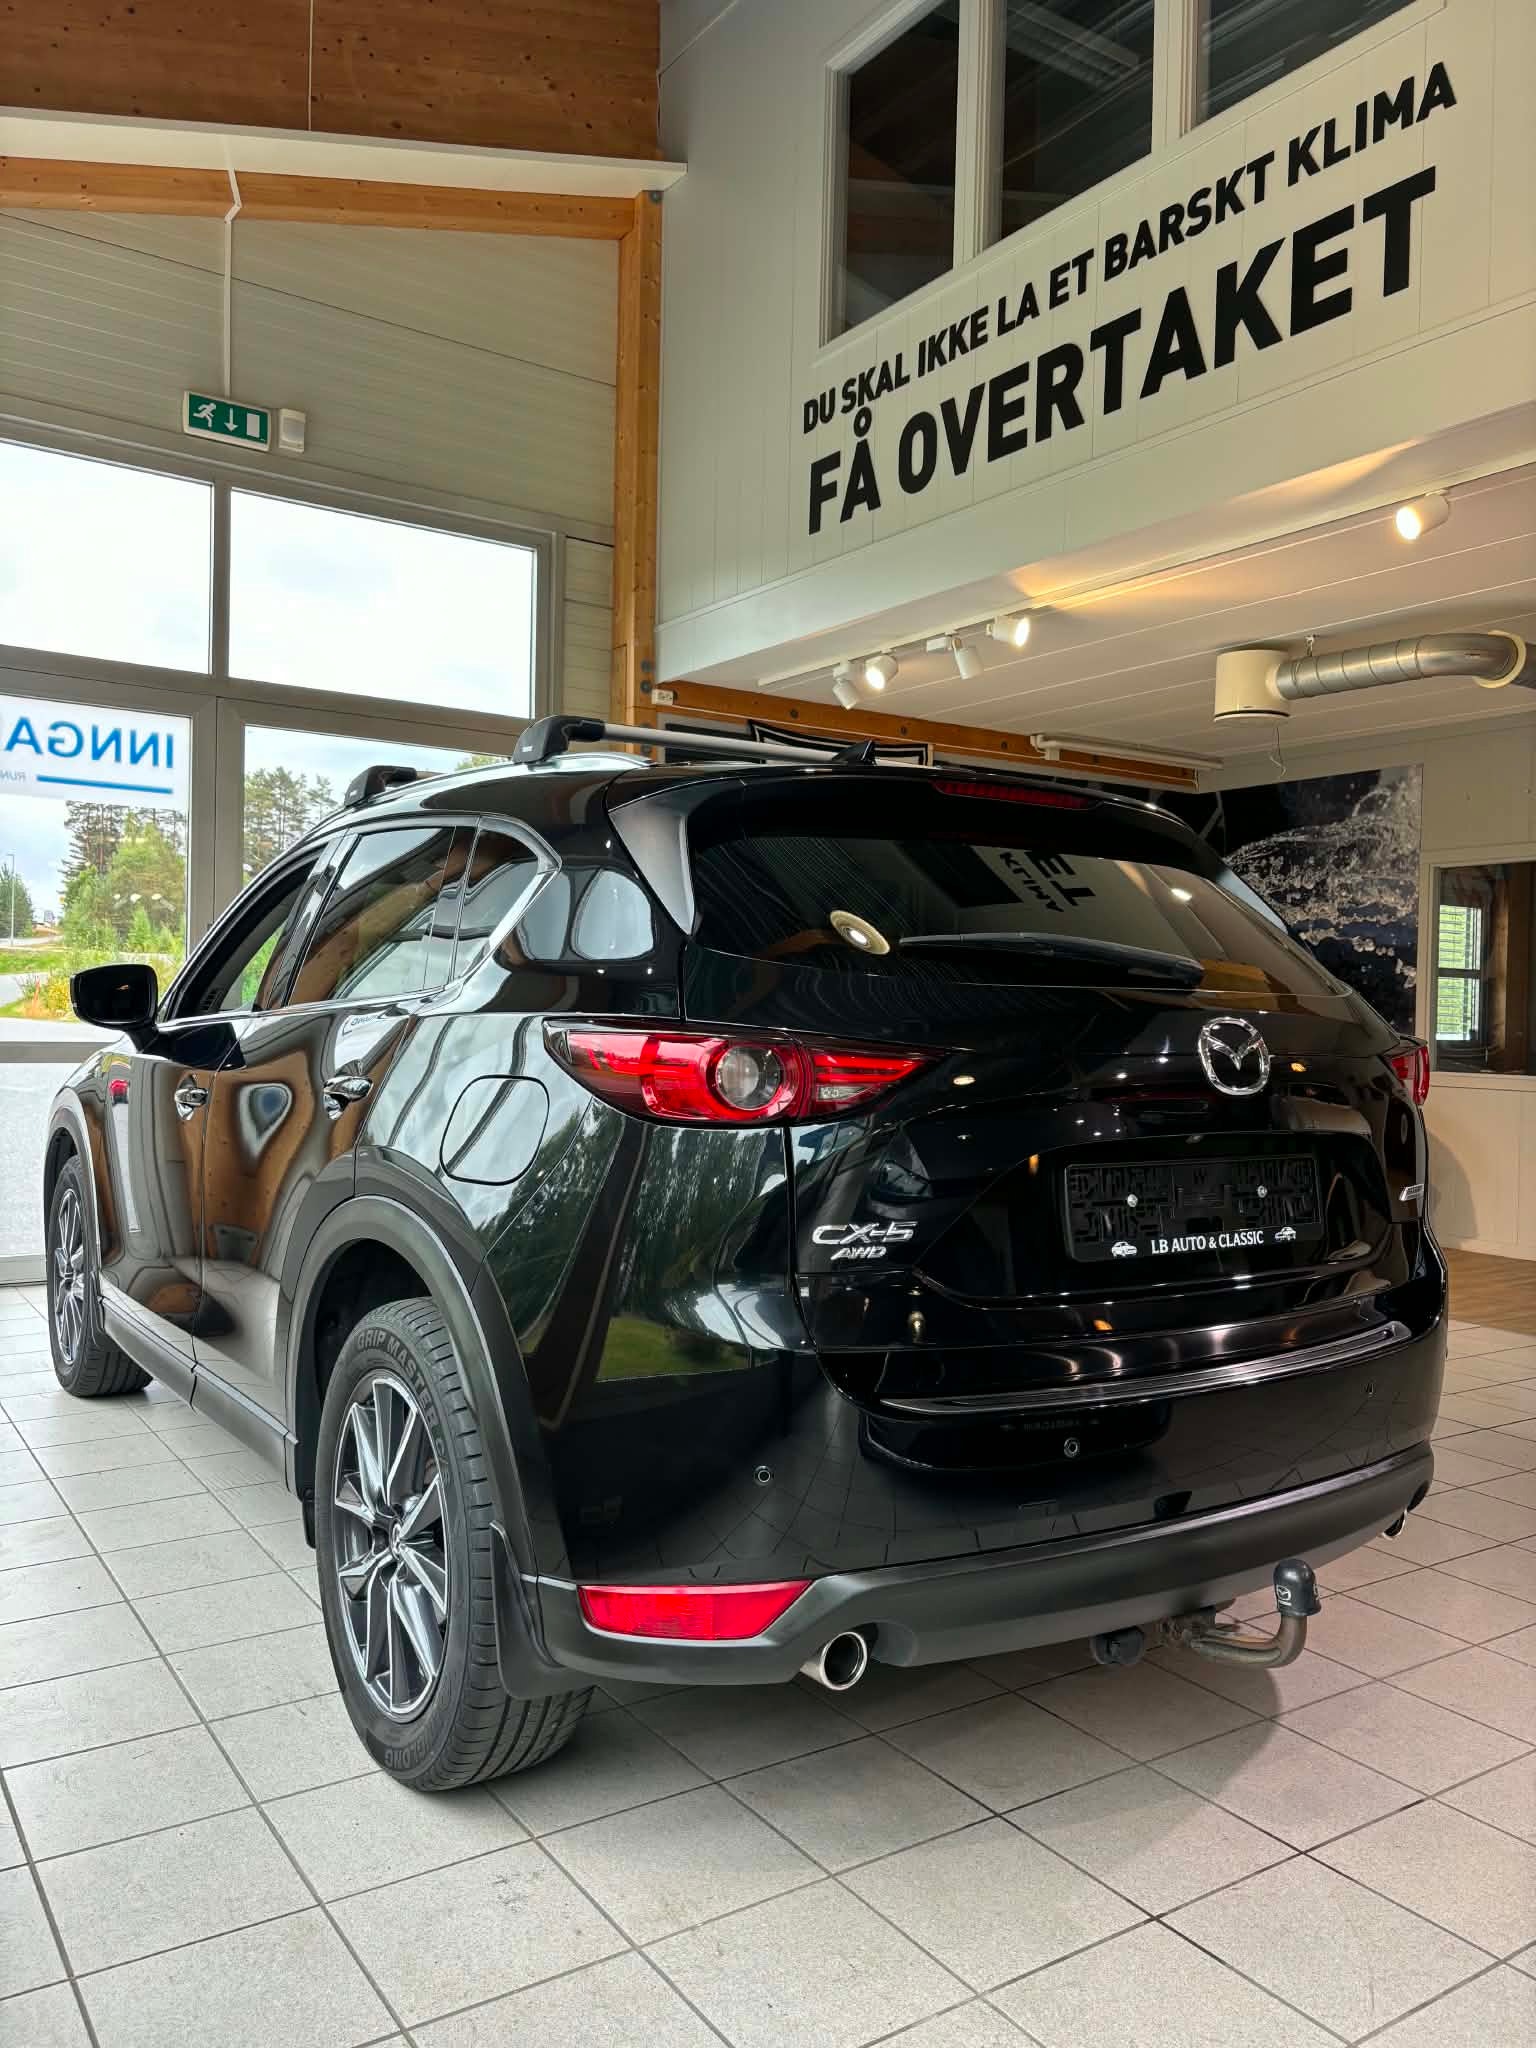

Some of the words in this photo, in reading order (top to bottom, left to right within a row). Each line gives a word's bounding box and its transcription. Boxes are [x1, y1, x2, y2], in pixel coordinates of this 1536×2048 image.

[804, 388, 836, 434] DU
[841, 353, 910, 413] SKAL
[918, 306, 988, 377] IKKE
[998, 283, 1041, 336] LA
[1049, 249, 1094, 309] ET
[1104, 151, 1274, 281] BARSKT
[1288, 62, 1456, 186] KLIMA
[809, 407, 881, 535] FÅ
[899, 166, 1436, 494] OVERTAKET
[812, 1221, 918, 1245] CX-5
[1151, 1239, 1169, 1254] LB
[1171, 1236, 1206, 1252] AUTO
[1208, 1237, 1217, 1249] &
[1218, 1230, 1264, 1248] CLASSIC
[830, 1246, 887, 1260] AWD
